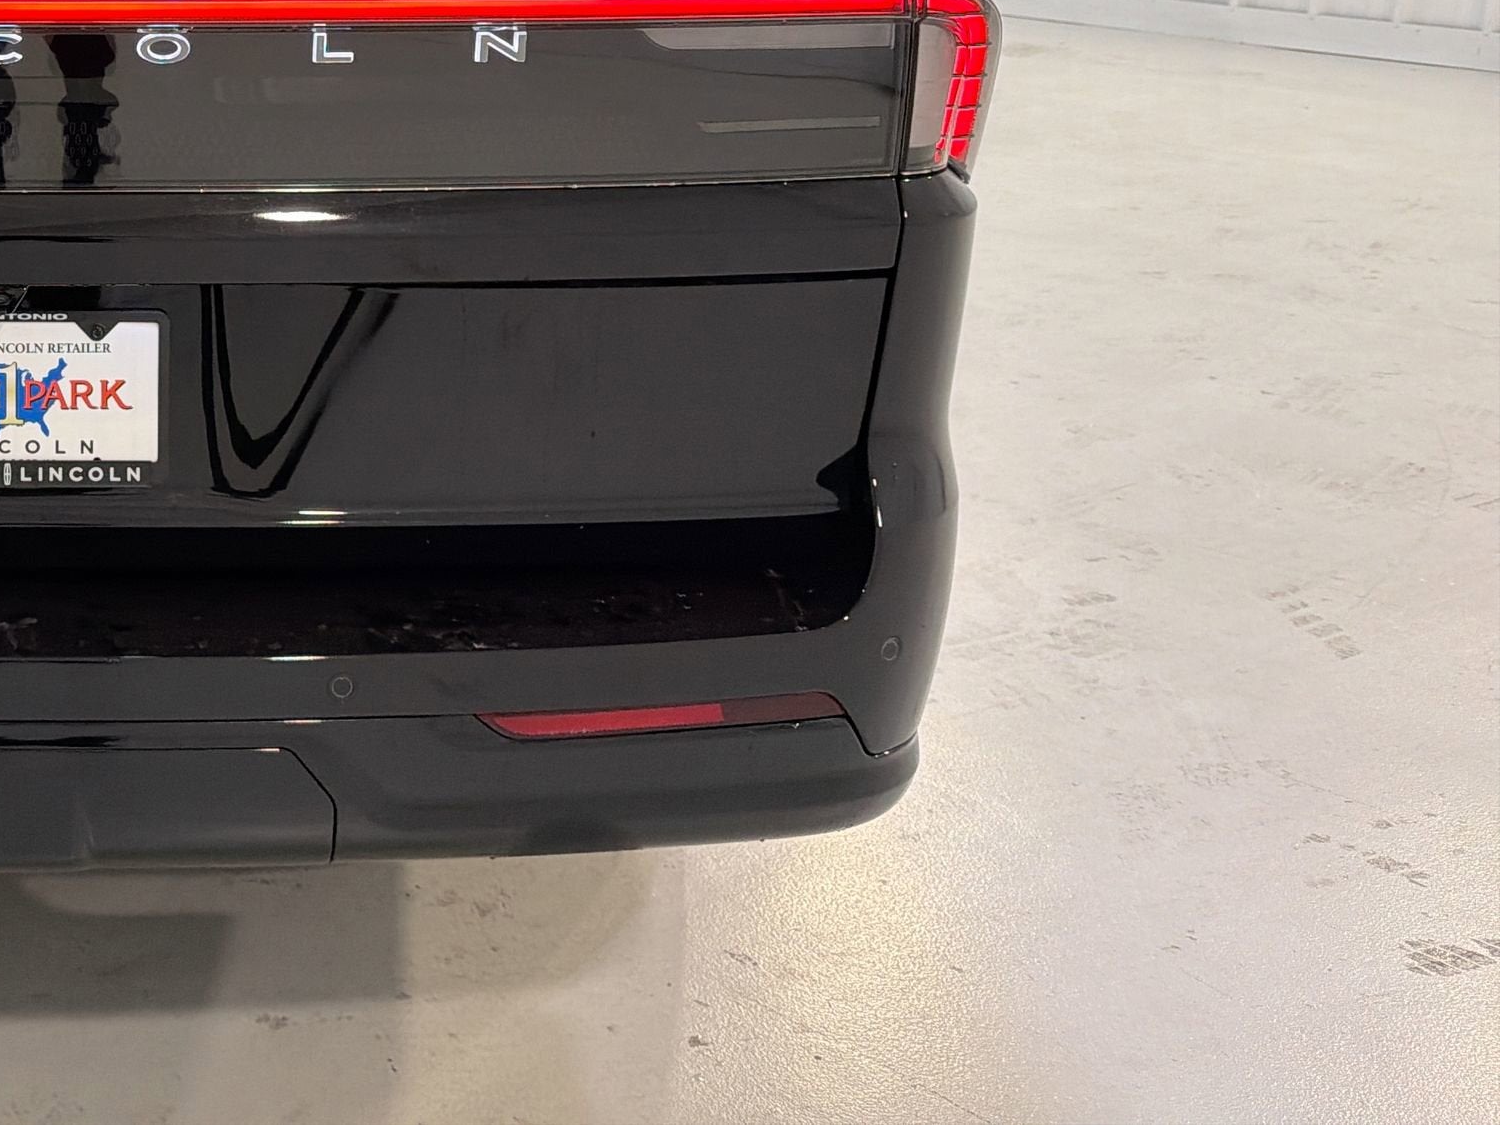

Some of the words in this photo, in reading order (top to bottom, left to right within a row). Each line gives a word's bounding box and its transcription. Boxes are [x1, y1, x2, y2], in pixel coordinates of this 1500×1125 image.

[48, 342, 111, 354] RETAILER
[24, 378, 133, 410] PARK
[20, 466, 141, 482] LINCOLN
